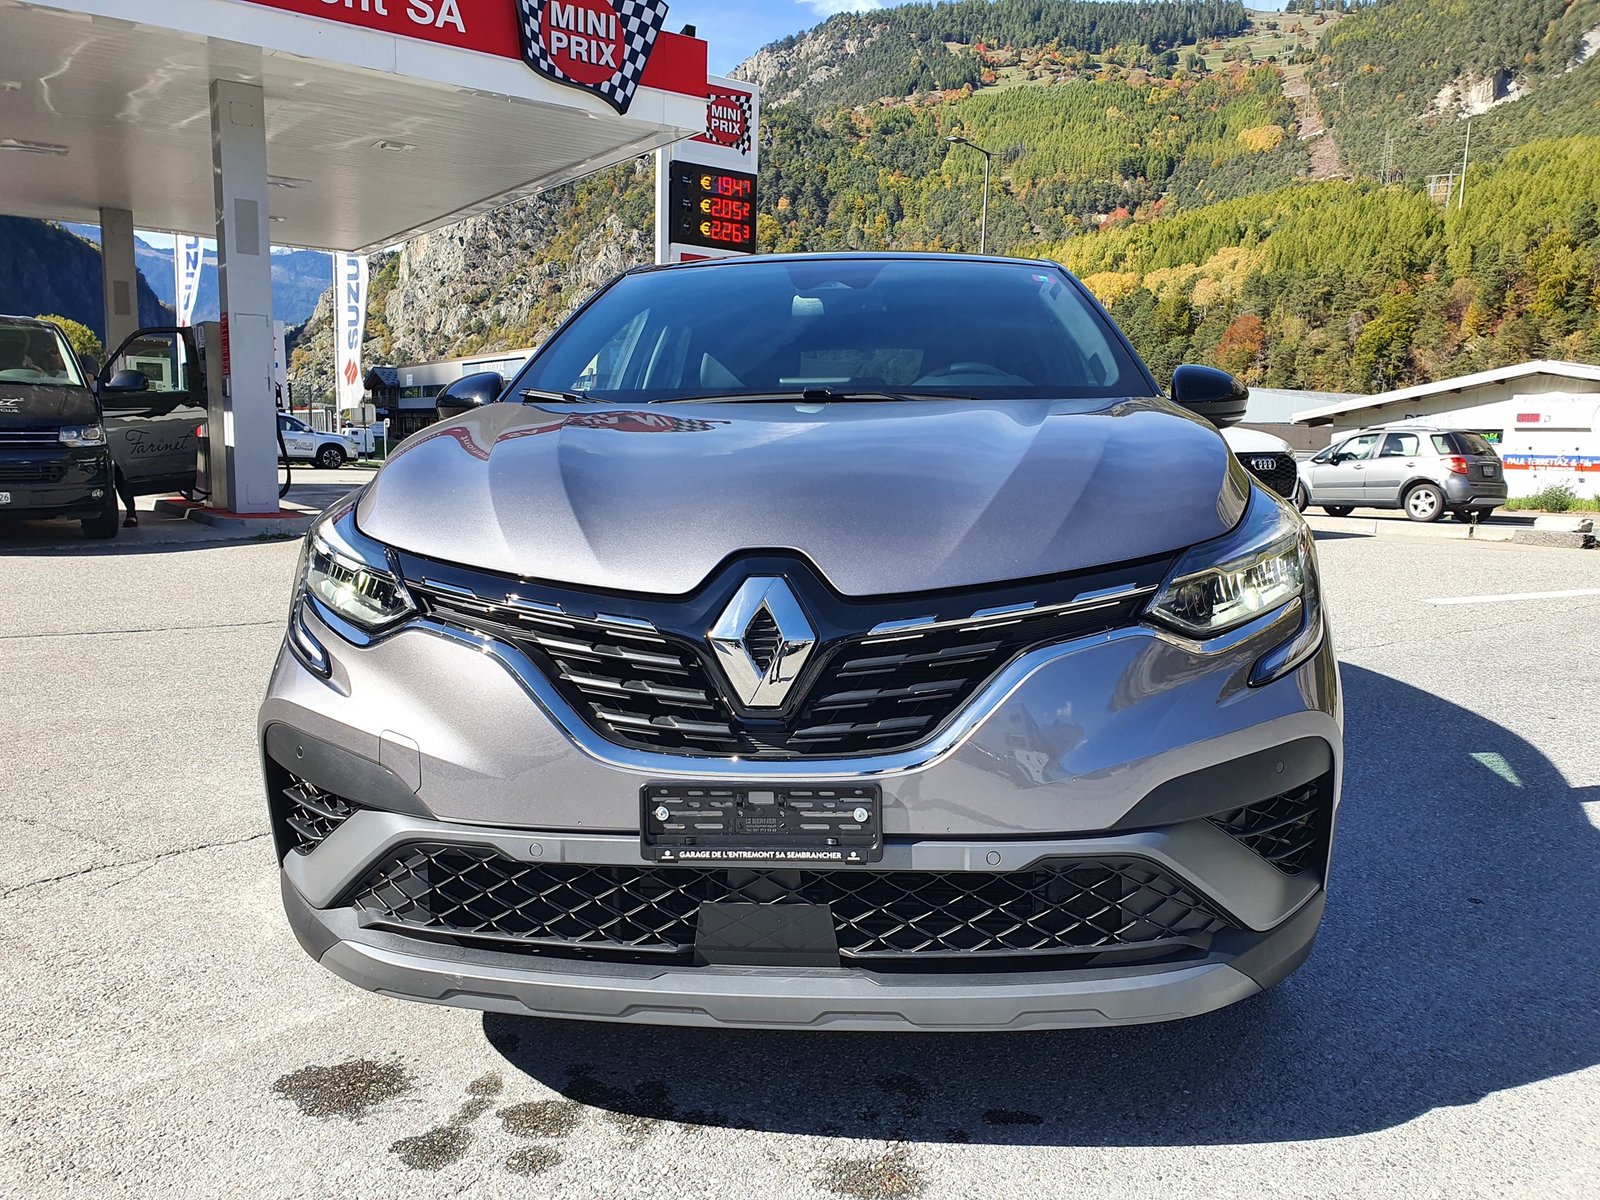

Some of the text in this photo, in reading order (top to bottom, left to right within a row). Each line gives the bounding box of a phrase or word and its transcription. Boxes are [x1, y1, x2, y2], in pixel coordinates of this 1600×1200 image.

[406, 0, 466, 33] SA
[550, 0, 616, 40] MINI
[550, 30, 617, 69] PRIX
[711, 104, 741, 122] MINI
[711, 119, 741, 135] PRIX
[347, 253, 360, 350] SUZU
[125, 429, 192, 455] Farinet
[679, 850, 842, 860] GARAGE DE L'ENTREMONT SA SEMBRANCHER
